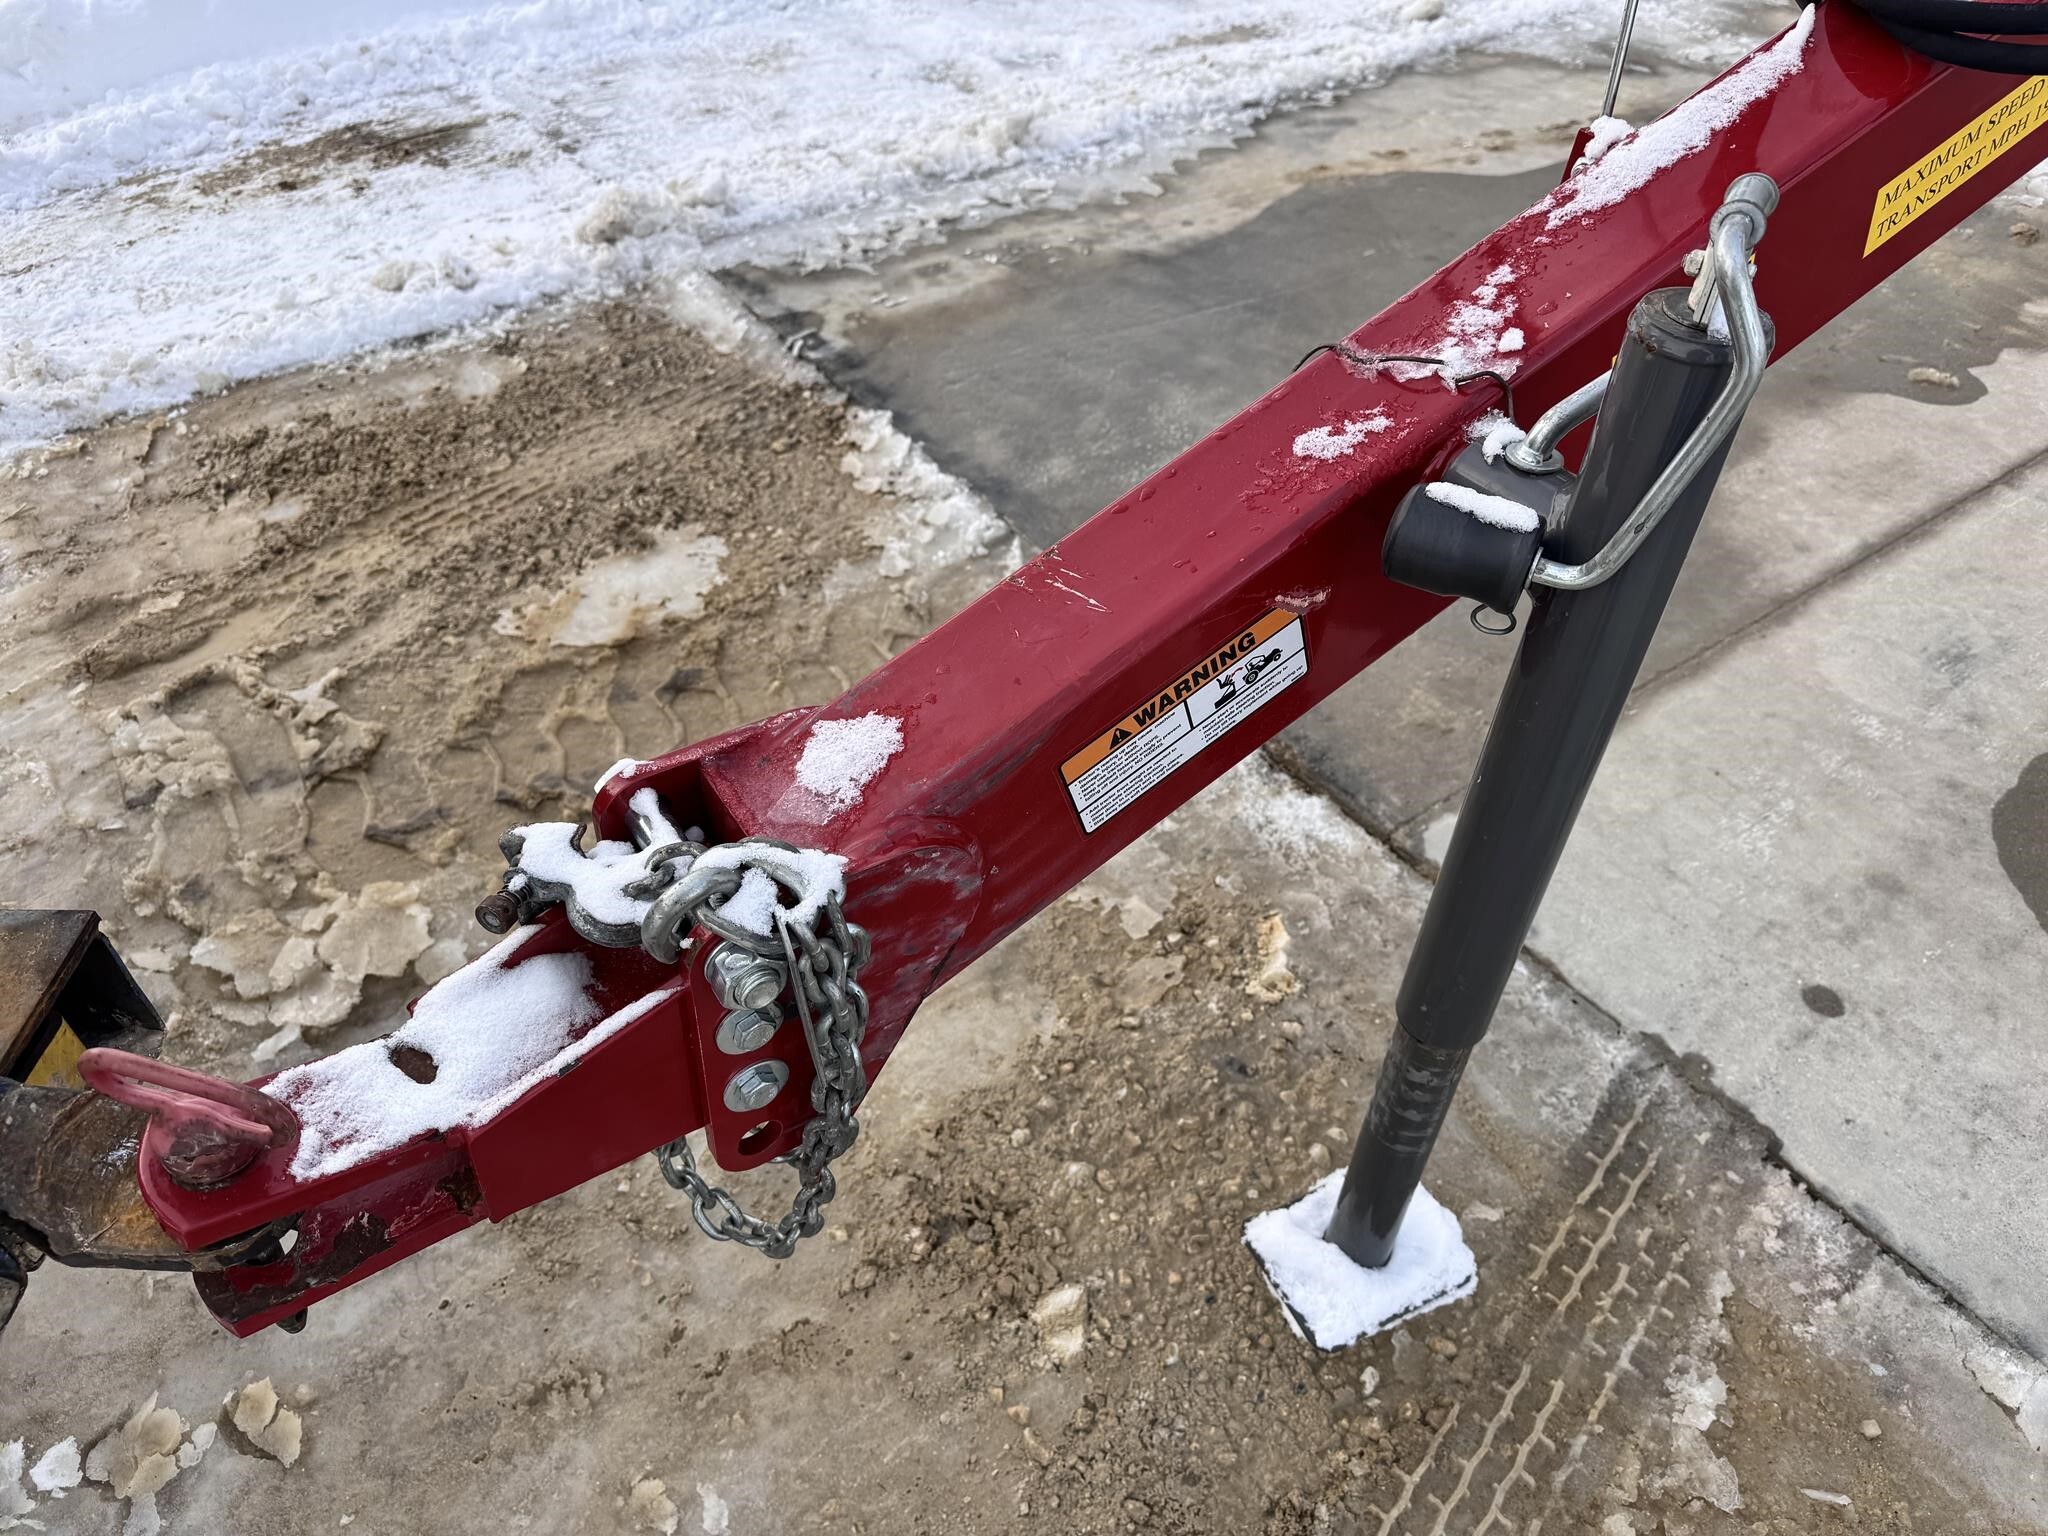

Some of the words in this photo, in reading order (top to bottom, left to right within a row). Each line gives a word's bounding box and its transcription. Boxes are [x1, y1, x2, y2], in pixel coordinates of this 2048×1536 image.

[1876, 146, 1987, 239] TRANSPORT
[1988, 112, 2031, 157] MPH
[1881, 122, 1983, 211] MAXIMUM
[1986, 79, 2045, 133] SPEED
[1133, 632, 1256, 728] WARNING
